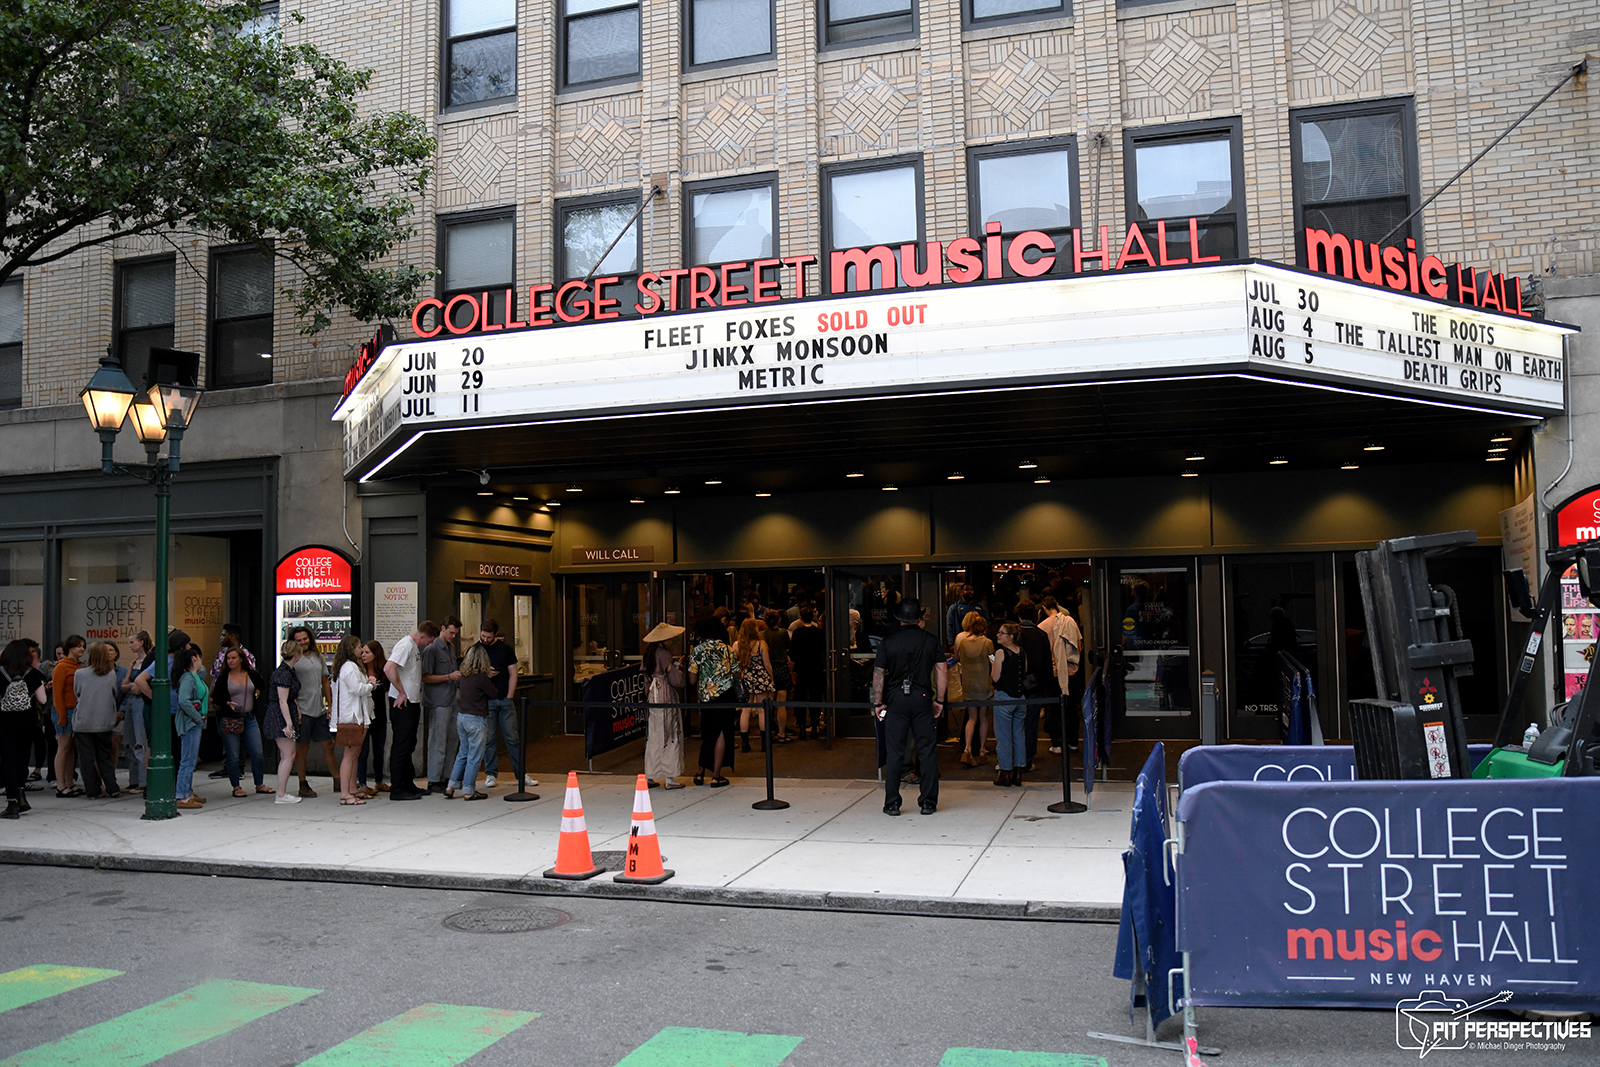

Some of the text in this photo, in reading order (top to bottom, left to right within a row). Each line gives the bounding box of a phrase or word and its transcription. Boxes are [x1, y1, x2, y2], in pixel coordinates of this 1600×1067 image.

[411, 217, 1221, 338] COLLEGE STREET music HALL
[1305, 227, 1532, 317] music HALL
[1249, 280, 1319, 313] JUL 30
[644, 304, 928, 349] FLEET FOXES SOLD OUT
[1251, 306, 1313, 338] AUG 4
[1412, 312, 1495, 346] THE ROOTS
[402, 346, 485, 373] JUN 20
[685, 333, 888, 370] JINKX MONSOON
[1251, 333, 1314, 364] AUG 5
[1335, 322, 1562, 380] THE TALLEST MAN ON EARTH
[402, 370, 484, 395] JUN 29
[738, 364, 824, 390] METRIC
[1404, 360, 1502, 393] DEATH GRIPS
[402, 397, 435, 418] JUL
[295, 557, 332, 567] COLLEGE
[585, 549, 639, 560] WILL CALL
[286, 576, 342, 588] music HALL
[295, 566, 332, 577] STREET
[479, 563, 520, 577] BOX OFFICE
[86, 595, 146, 611] COLLEGE
[184, 596, 221, 607] COLLEGE
[184, 606, 221, 617] STREET
[1564, 600, 1588, 608] LIPS
[86, 611, 146, 627] STREET
[184, 617, 206, 625] music
[86, 627, 119, 639] music
[610, 673, 645, 699] COLLEG
[1245, 704, 1258, 712] NO
[612, 714, 635, 734] music
[1282, 807, 1567, 860] COLLEGE
[1283, 862, 1568, 917] STREET
[1287, 919, 1578, 964] music HALL
[1370, 972, 1492, 987] NEW HAVEN
